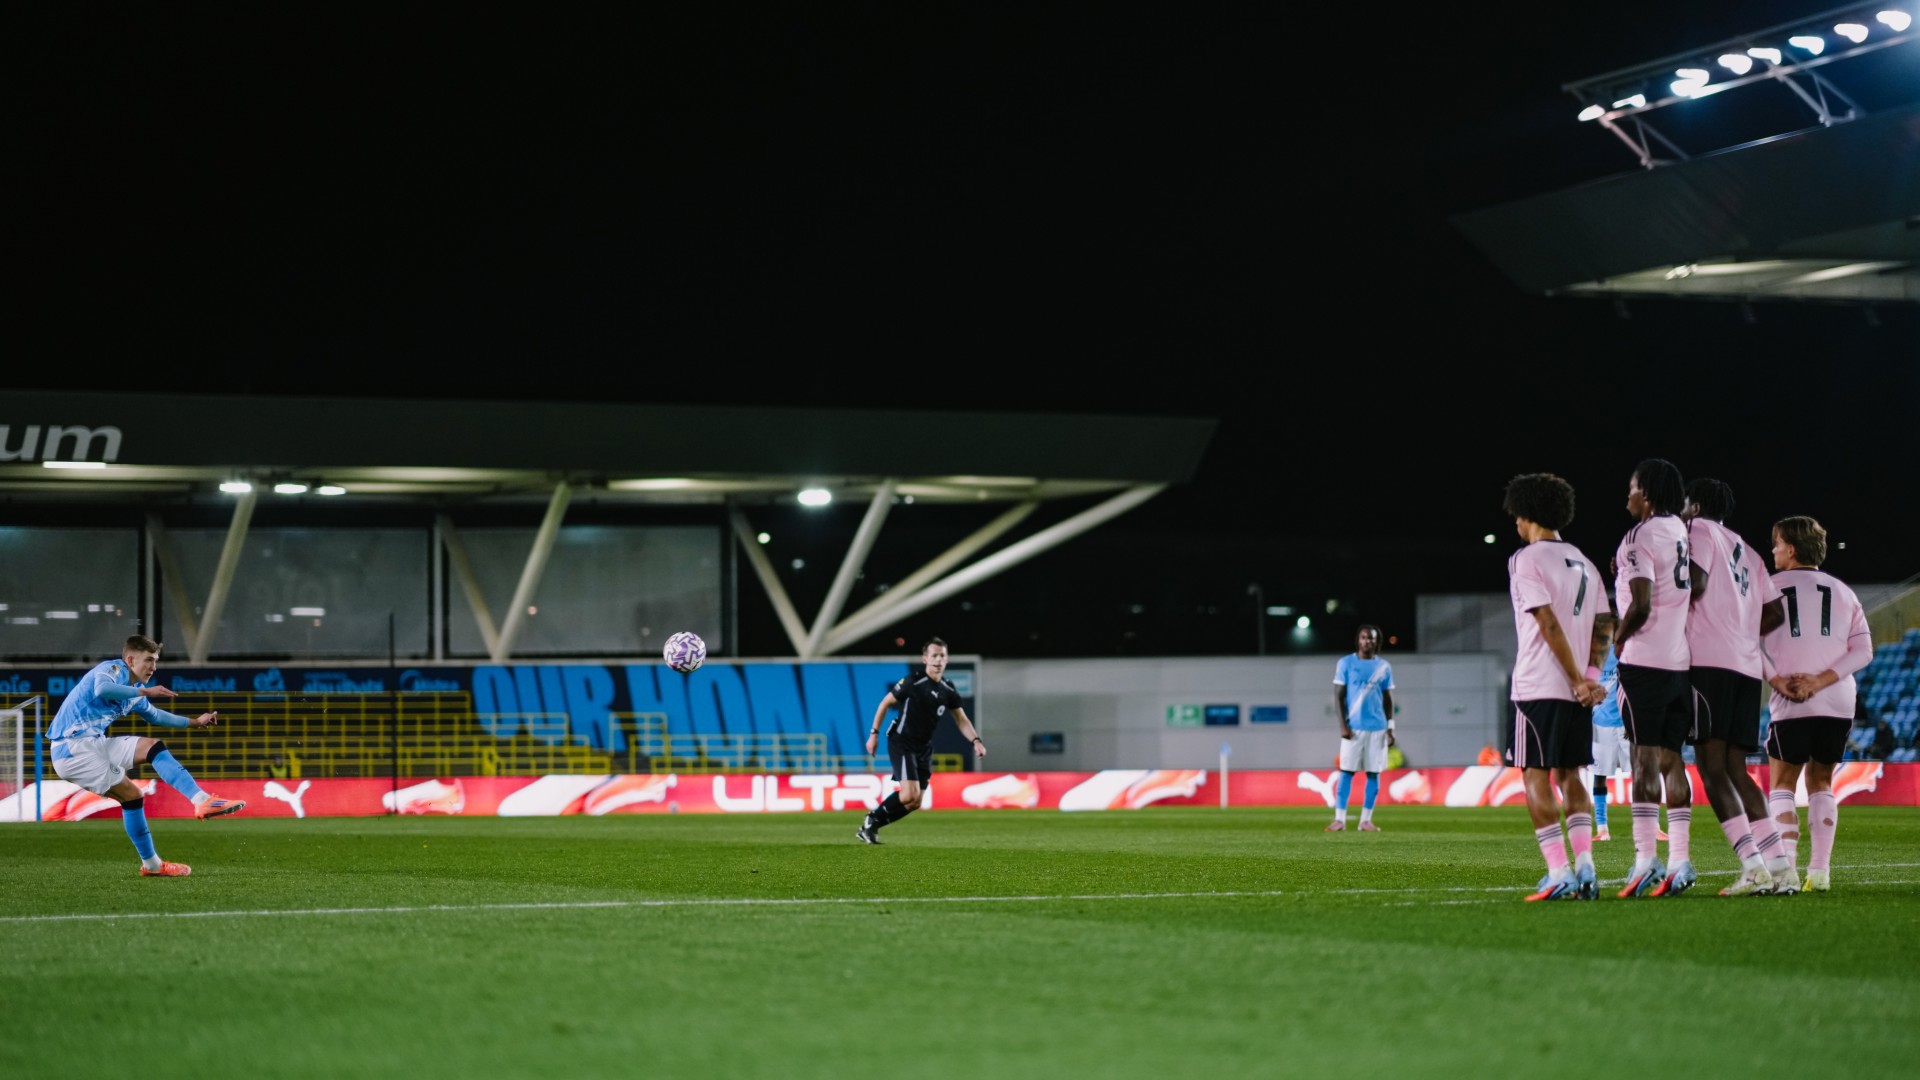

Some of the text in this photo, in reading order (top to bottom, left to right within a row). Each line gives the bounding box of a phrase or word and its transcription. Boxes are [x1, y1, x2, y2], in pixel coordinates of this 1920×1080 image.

[0, 425, 122, 461] um
[1565, 558, 1588, 616] 7
[1780, 584, 1832, 637] 11
[171, 675, 237, 691] Revolut
[472, 666, 626, 754] OUR
